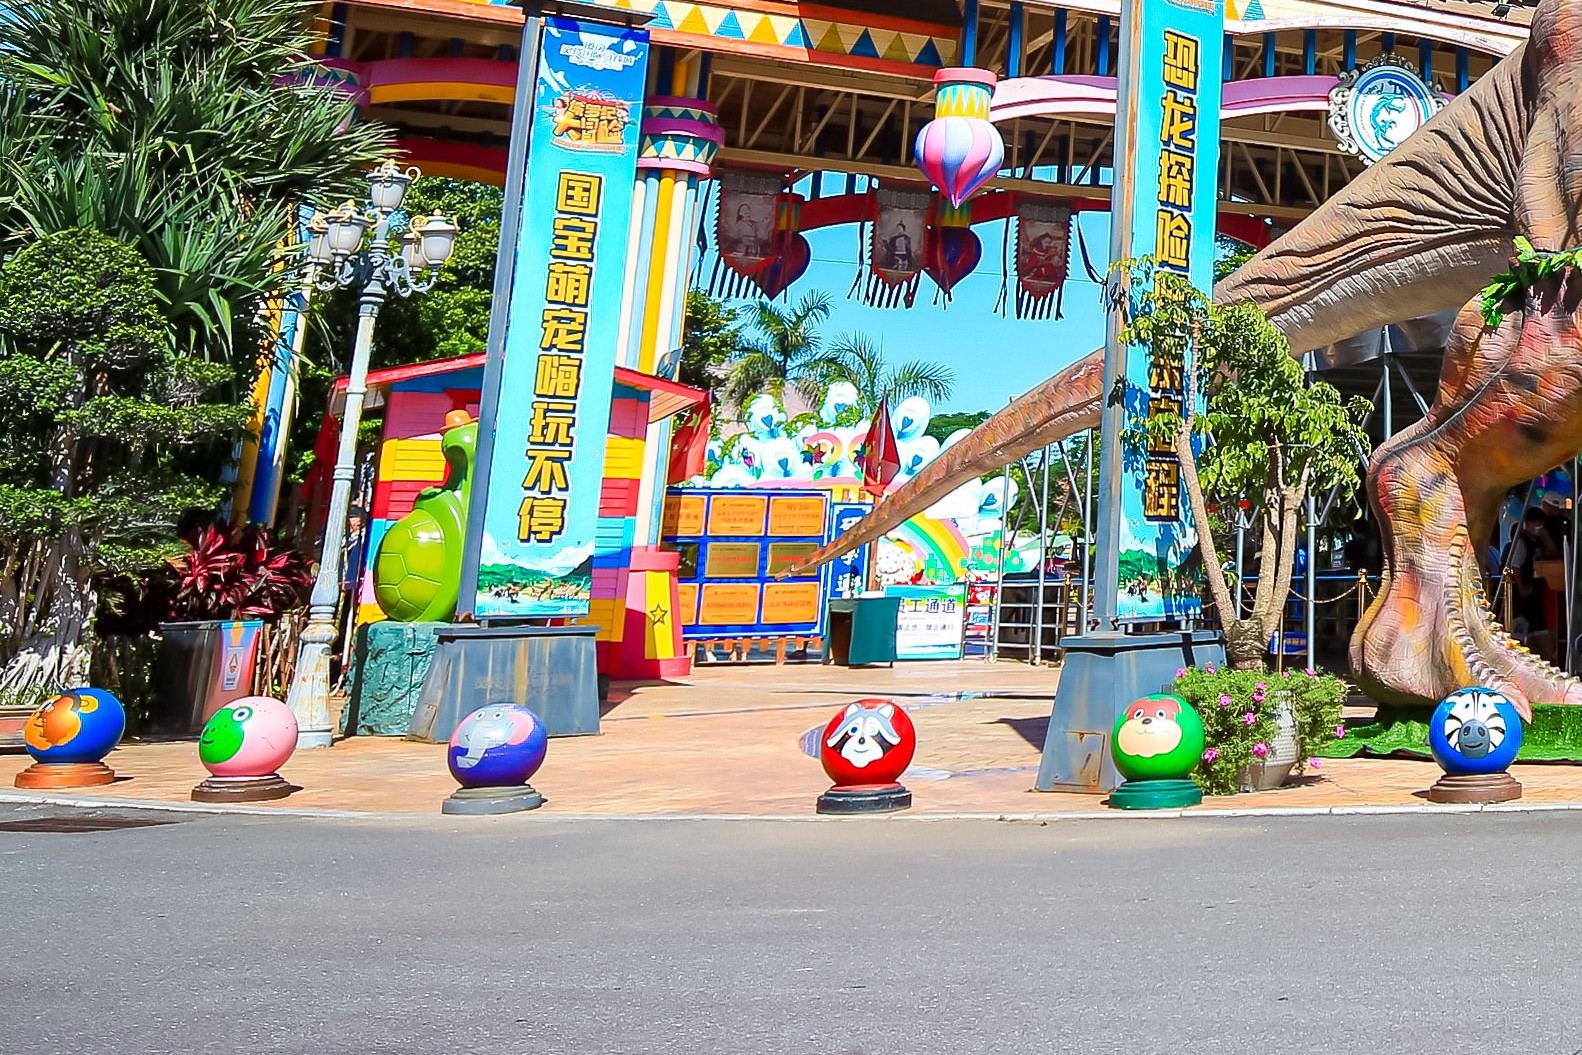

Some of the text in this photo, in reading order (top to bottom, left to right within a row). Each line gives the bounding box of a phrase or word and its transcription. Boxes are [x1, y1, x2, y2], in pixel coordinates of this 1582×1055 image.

[517, 172, 601, 542] 国宝萌宠嗨玩不停
